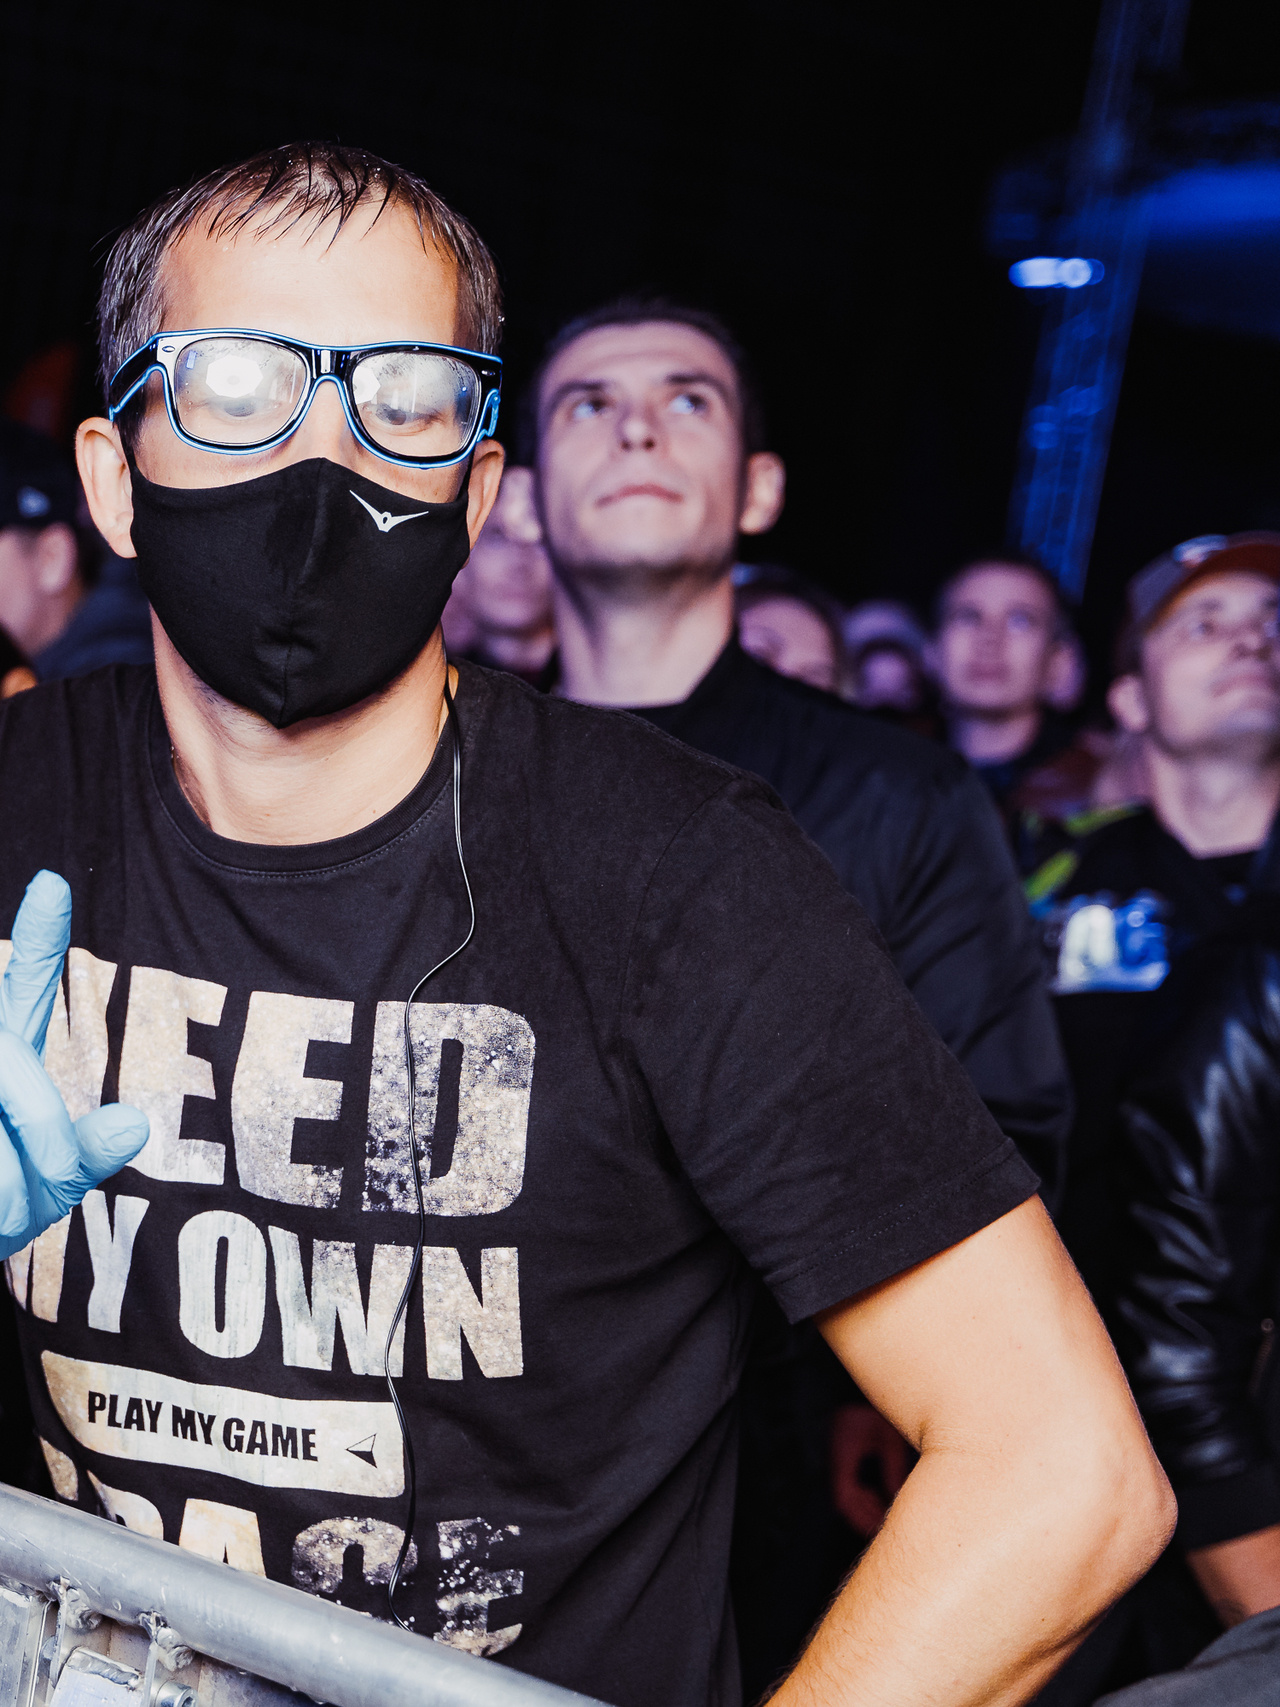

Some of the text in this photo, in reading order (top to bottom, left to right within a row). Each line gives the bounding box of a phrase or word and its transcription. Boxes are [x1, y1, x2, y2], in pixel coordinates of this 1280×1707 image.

[178, 1210, 523, 1380] OWN
[88, 1390, 319, 1462] PLAY MY GAME
